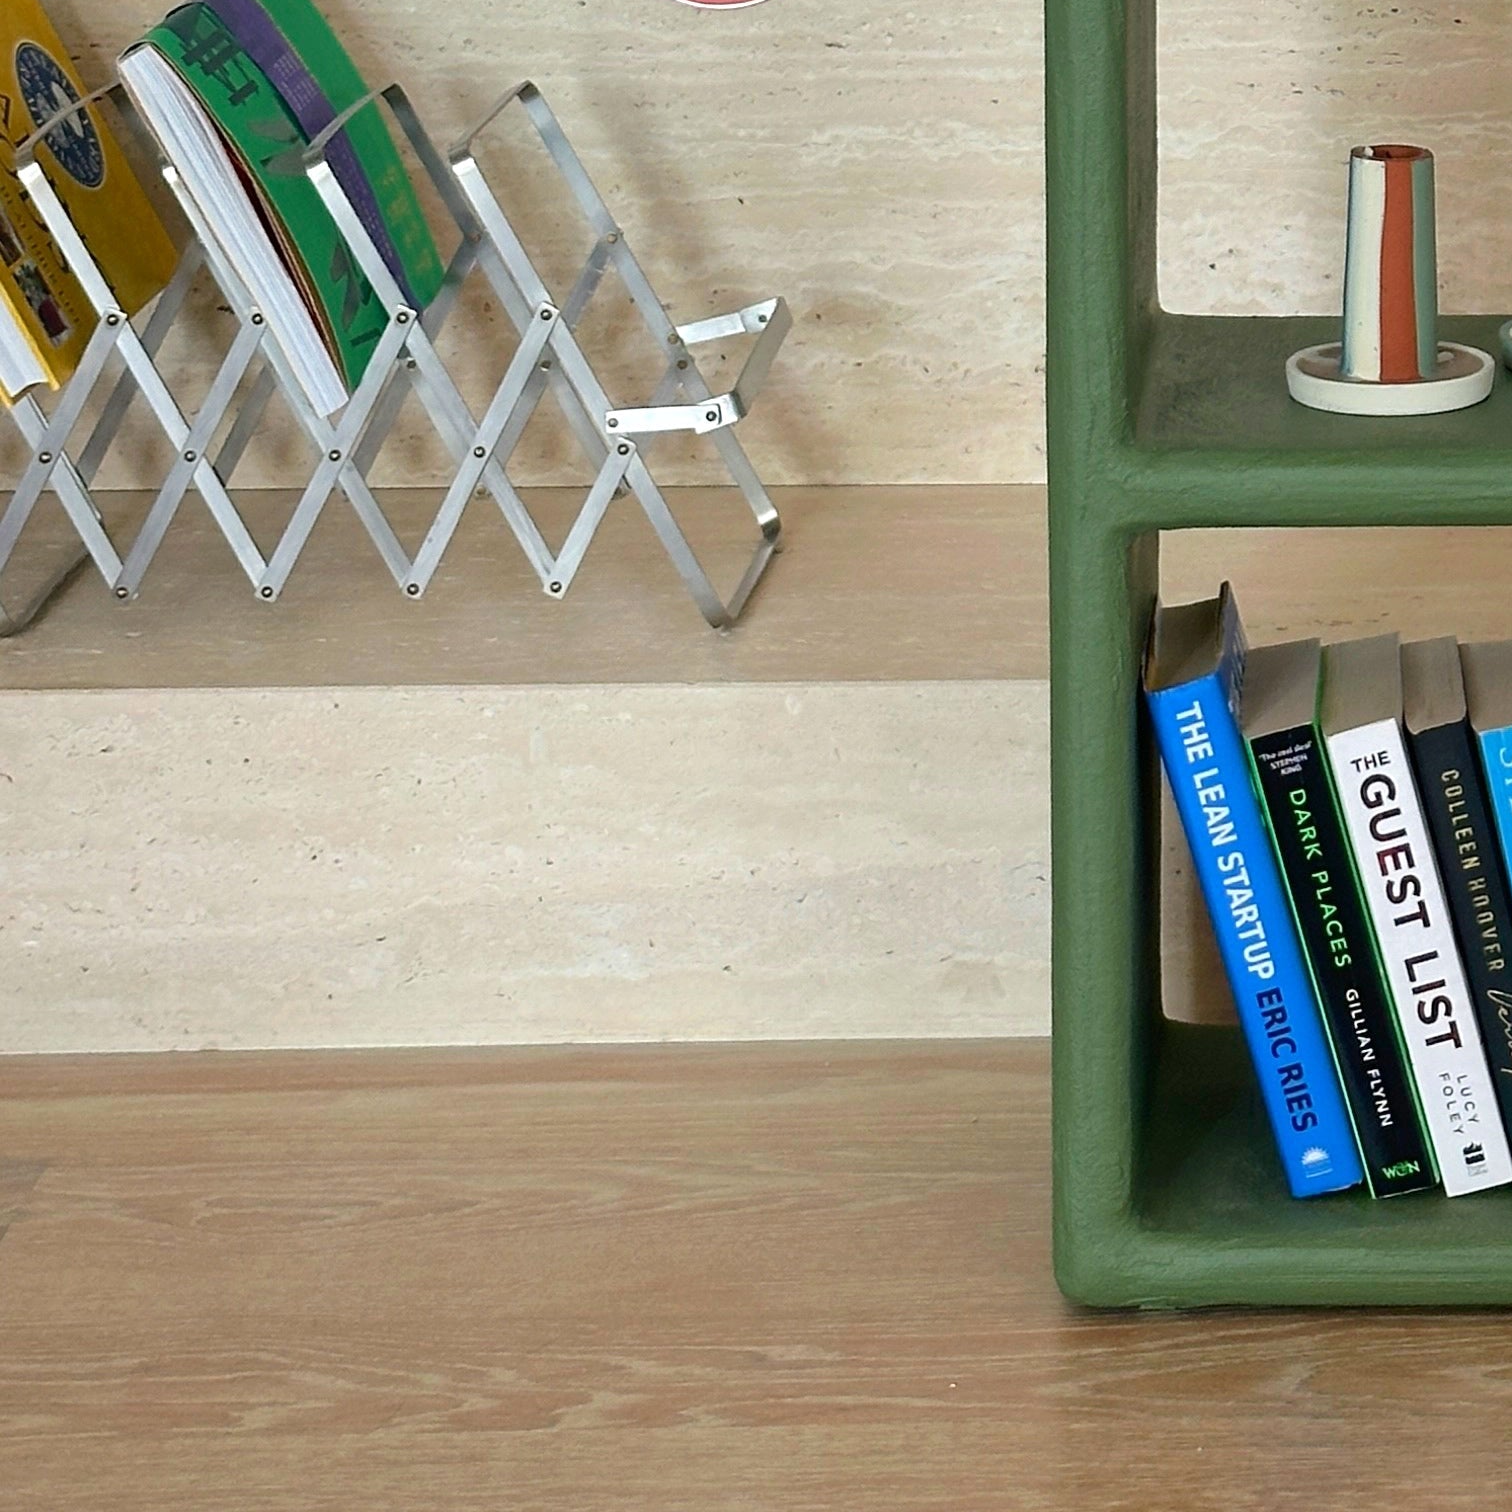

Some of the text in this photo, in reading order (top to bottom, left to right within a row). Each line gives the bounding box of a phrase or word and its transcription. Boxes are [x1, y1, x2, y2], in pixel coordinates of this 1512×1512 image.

[1350, 750, 1392, 774] THE
[1176, 700, 1319, 1133] THE LEAN STARTUP ERIC RIES
[1289, 788, 1352, 968] DARK PLACES
[1359, 773, 1463, 1050] GUEST LIST
[1441, 768, 1506, 972] COLLEEN HOOVER
[1345, 989, 1394, 1128] GILLIAN FLYNN
[1438, 1072, 1465, 1135] FOLEY
[1456, 1074, 1480, 1125] LUCY
